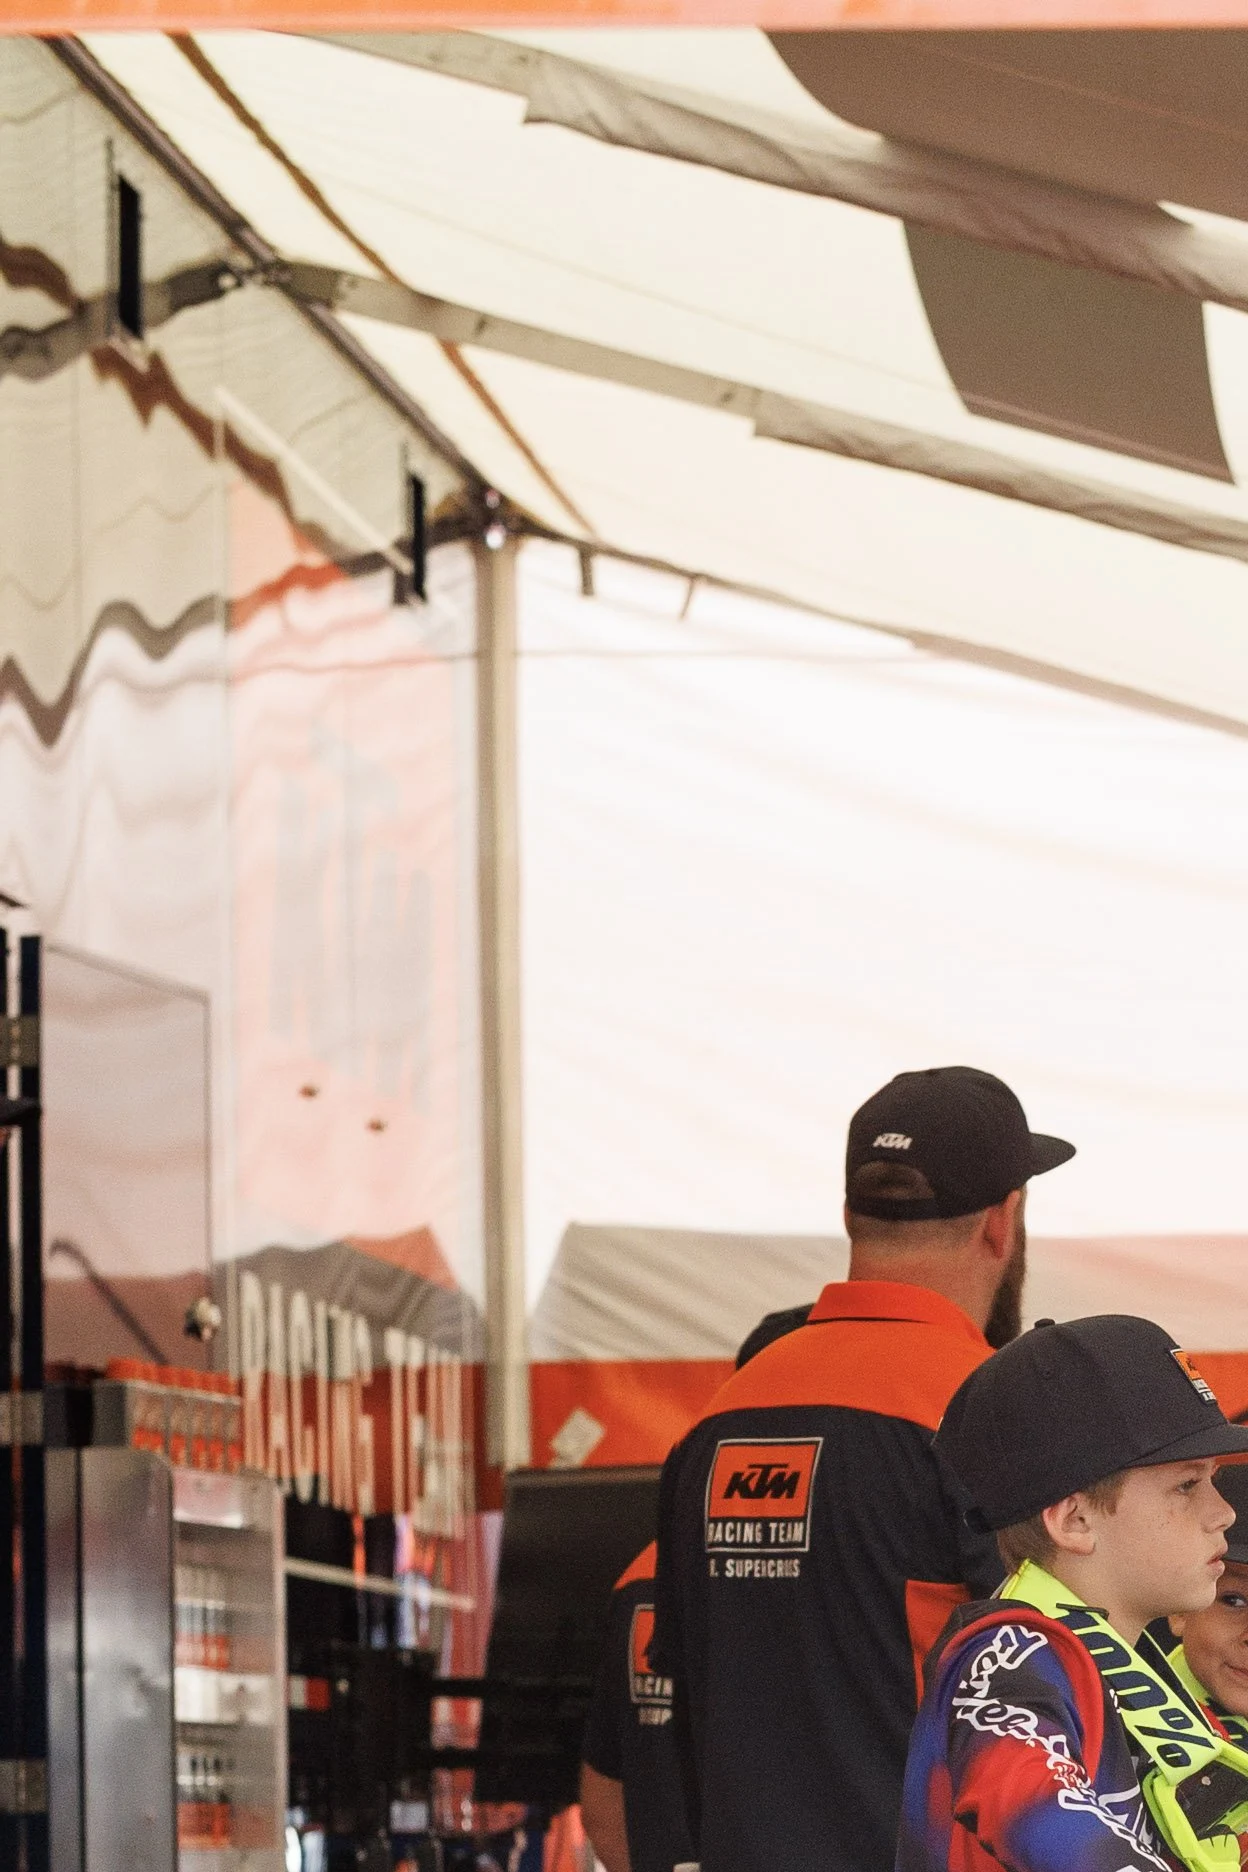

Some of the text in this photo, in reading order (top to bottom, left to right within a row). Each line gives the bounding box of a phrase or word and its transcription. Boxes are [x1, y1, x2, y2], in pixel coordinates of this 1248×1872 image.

[873, 1133, 912, 1149] KTM
[723, 1463, 800, 1499] KTM
[769, 1521, 804, 1543] TEAM
[1053, 1612, 1217, 1768] 100%
